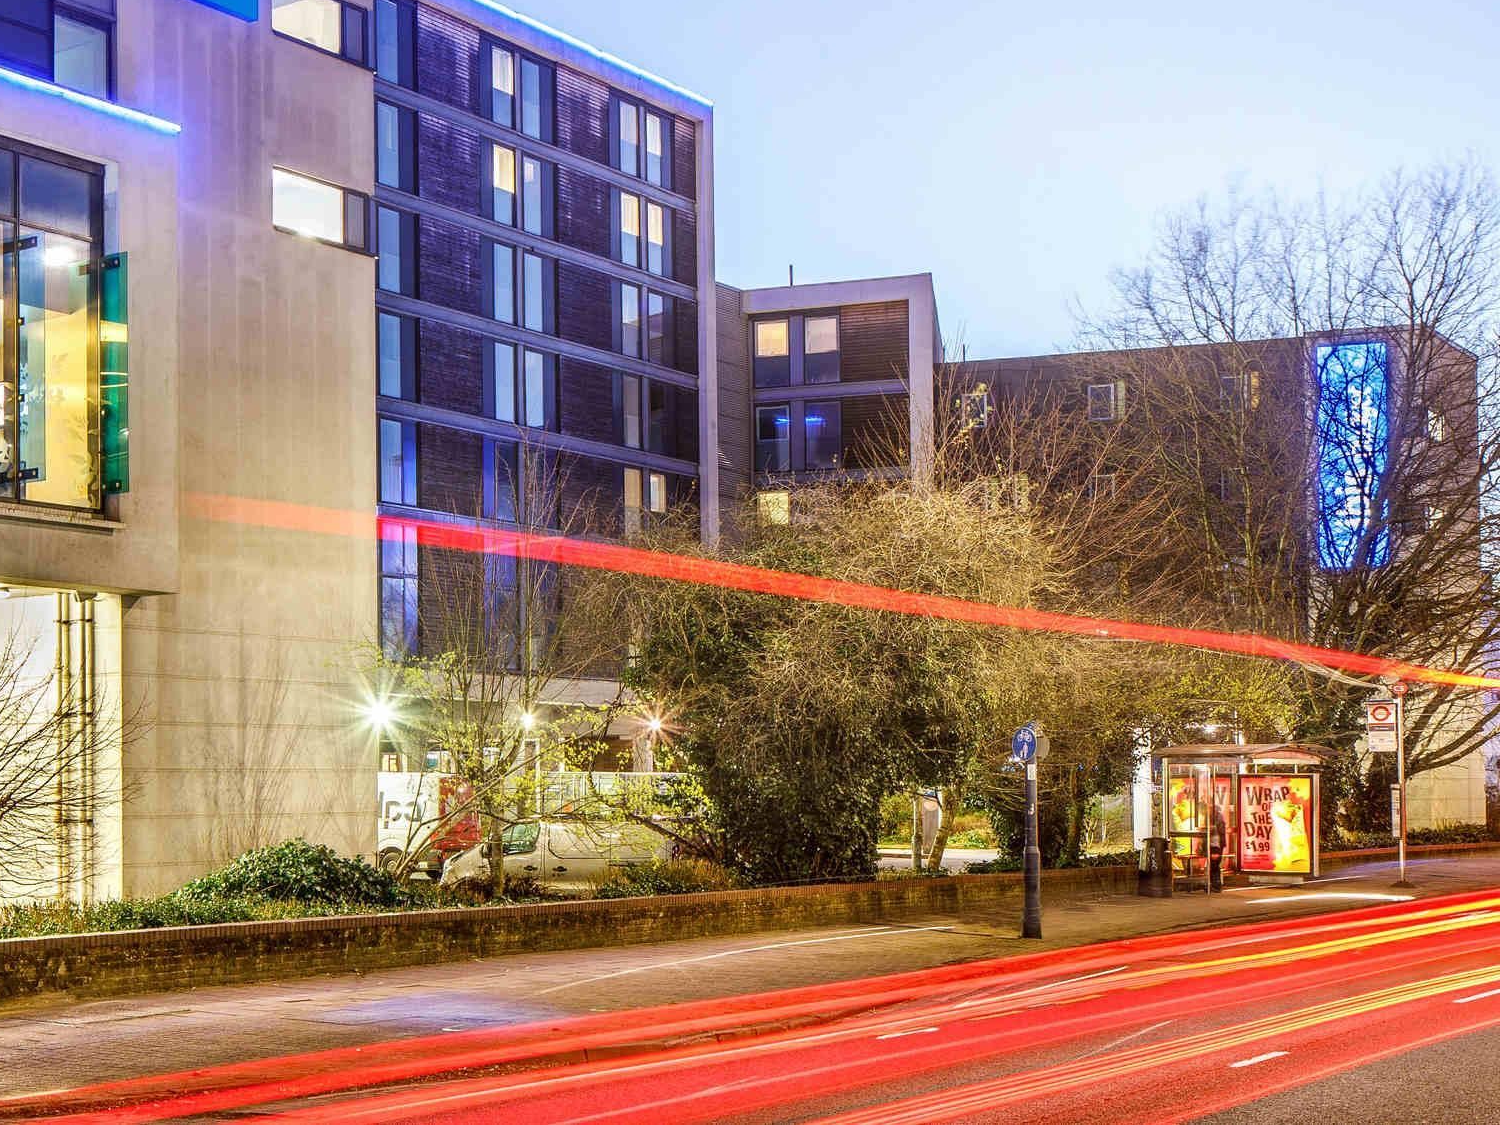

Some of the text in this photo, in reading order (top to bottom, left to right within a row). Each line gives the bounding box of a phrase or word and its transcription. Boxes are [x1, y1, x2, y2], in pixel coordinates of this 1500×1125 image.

[1245, 785, 1290, 806] WRAP
[1250, 811, 1273, 825] THE
[1244, 821, 1273, 841] DAY
[1245, 840, 1270, 852] £1.99
